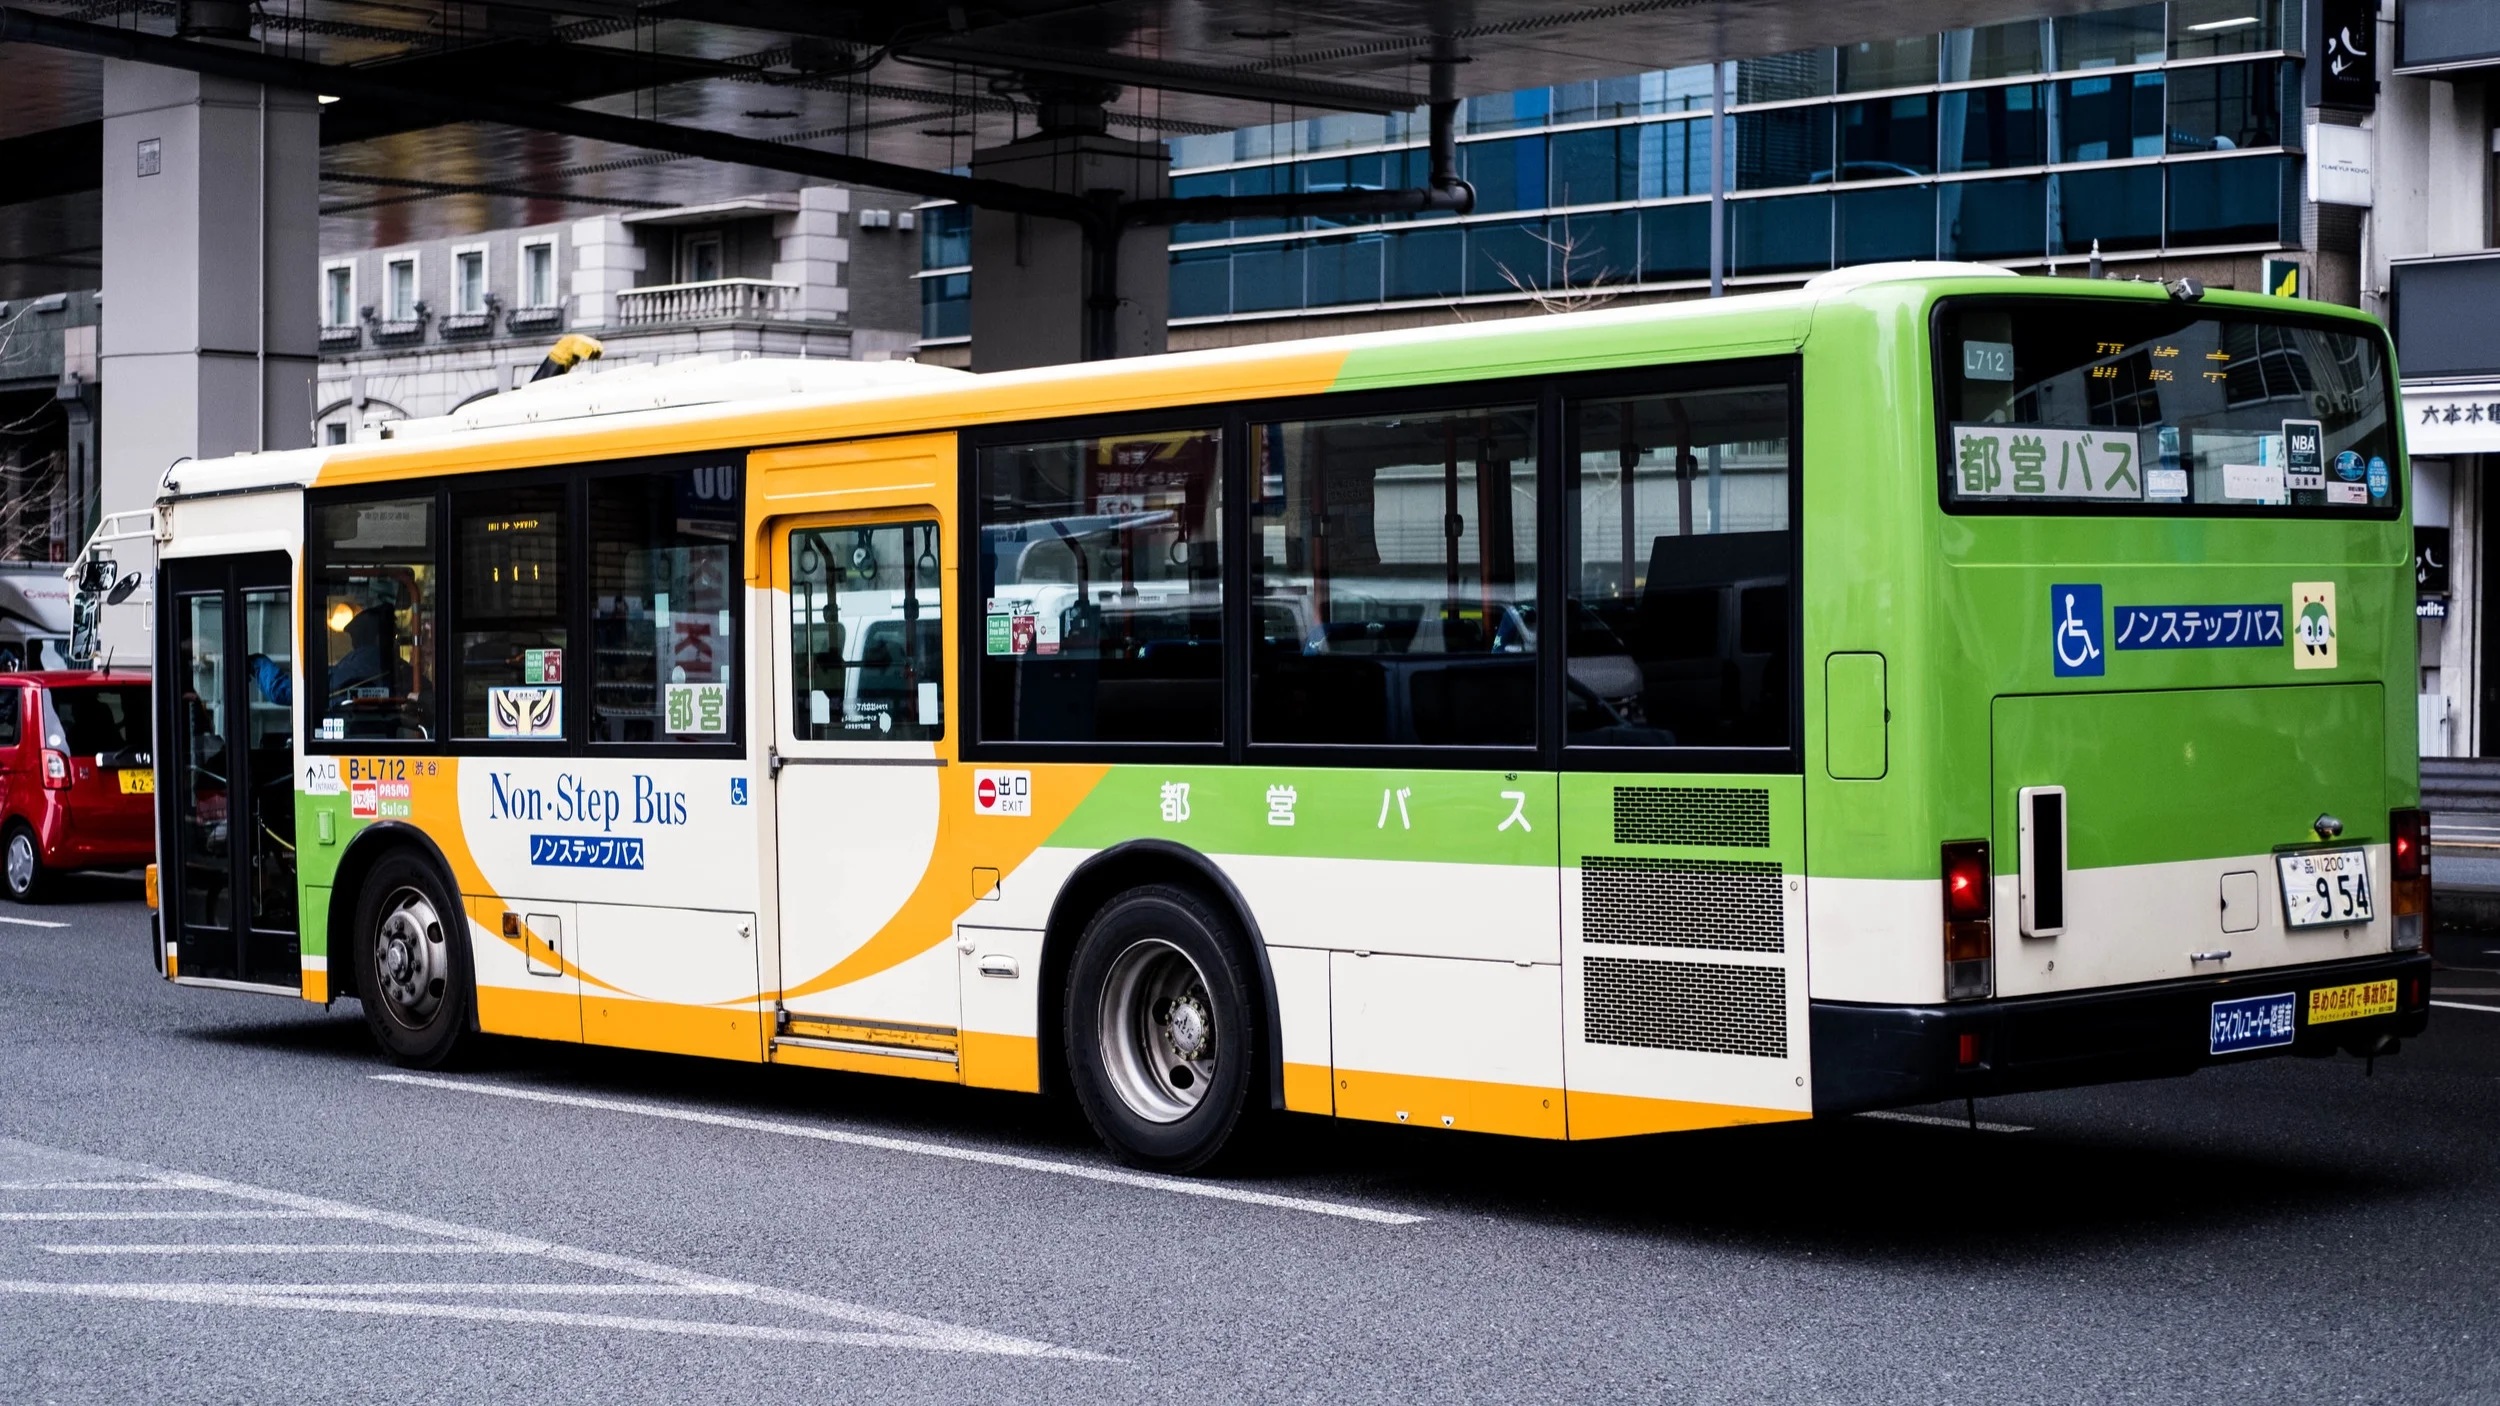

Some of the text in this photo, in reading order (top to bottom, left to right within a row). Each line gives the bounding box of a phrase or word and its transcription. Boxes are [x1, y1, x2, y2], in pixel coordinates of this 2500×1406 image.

[1967, 350, 2005, 372] L712
[2292, 435, 2316, 451] NBA
[1960, 433, 2137, 493] 都営バス
[2416, 601, 2445, 616] erlitz
[2118, 610, 2283, 643] ノンステップバス
[668, 687, 723, 731] 都営
[318, 764, 336, 779] 入口
[350, 759, 405, 781] B-L712
[380, 784, 409, 797] PASMO
[998, 776, 1027, 796] 出口
[381, 802, 408, 816] Suica
[632, 775, 688, 826] Bus
[1002, 800, 1023, 812] EXIT
[1160, 781, 1532, 833] 都営バス
[532, 838, 644, 867] ノンステップバス
